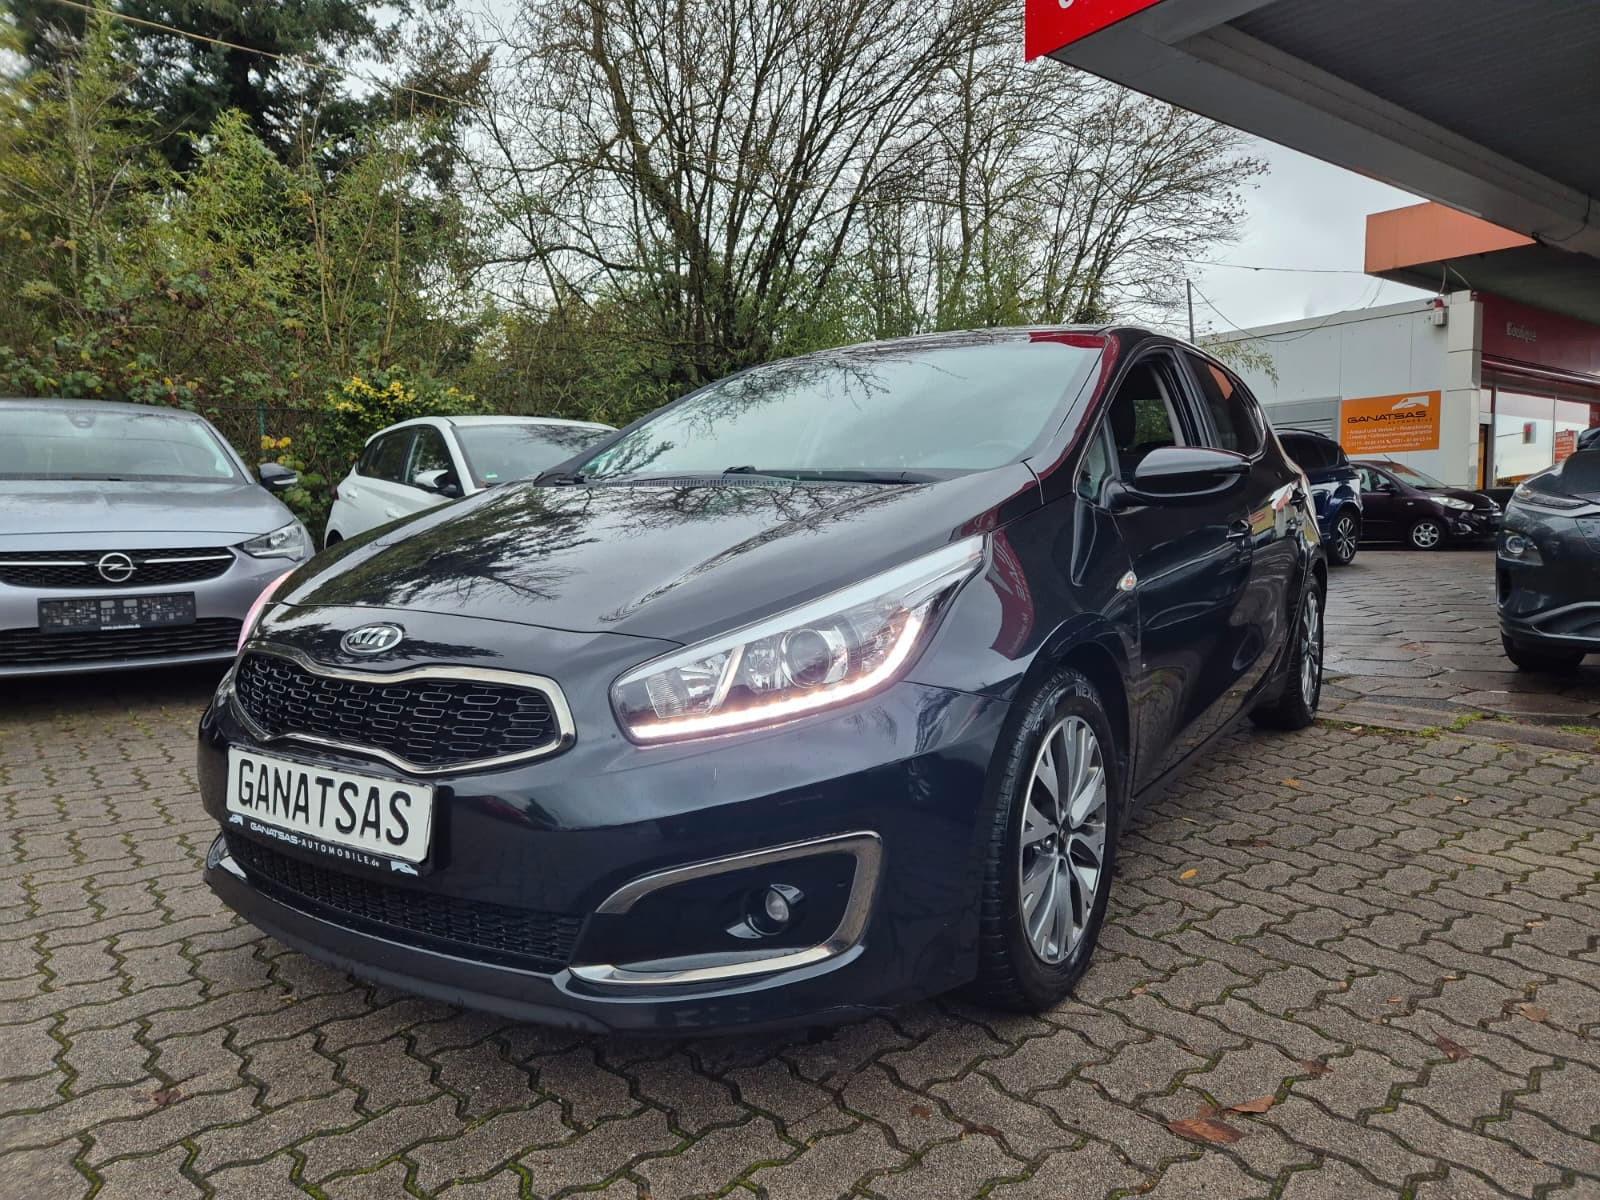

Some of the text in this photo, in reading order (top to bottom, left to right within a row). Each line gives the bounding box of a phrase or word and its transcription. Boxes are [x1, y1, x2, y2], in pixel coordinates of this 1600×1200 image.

[1347, 410, 1426, 424] GANATSAS
[348, 627, 392, 647] KIA
[238, 758, 412, 846] GANATSAS
